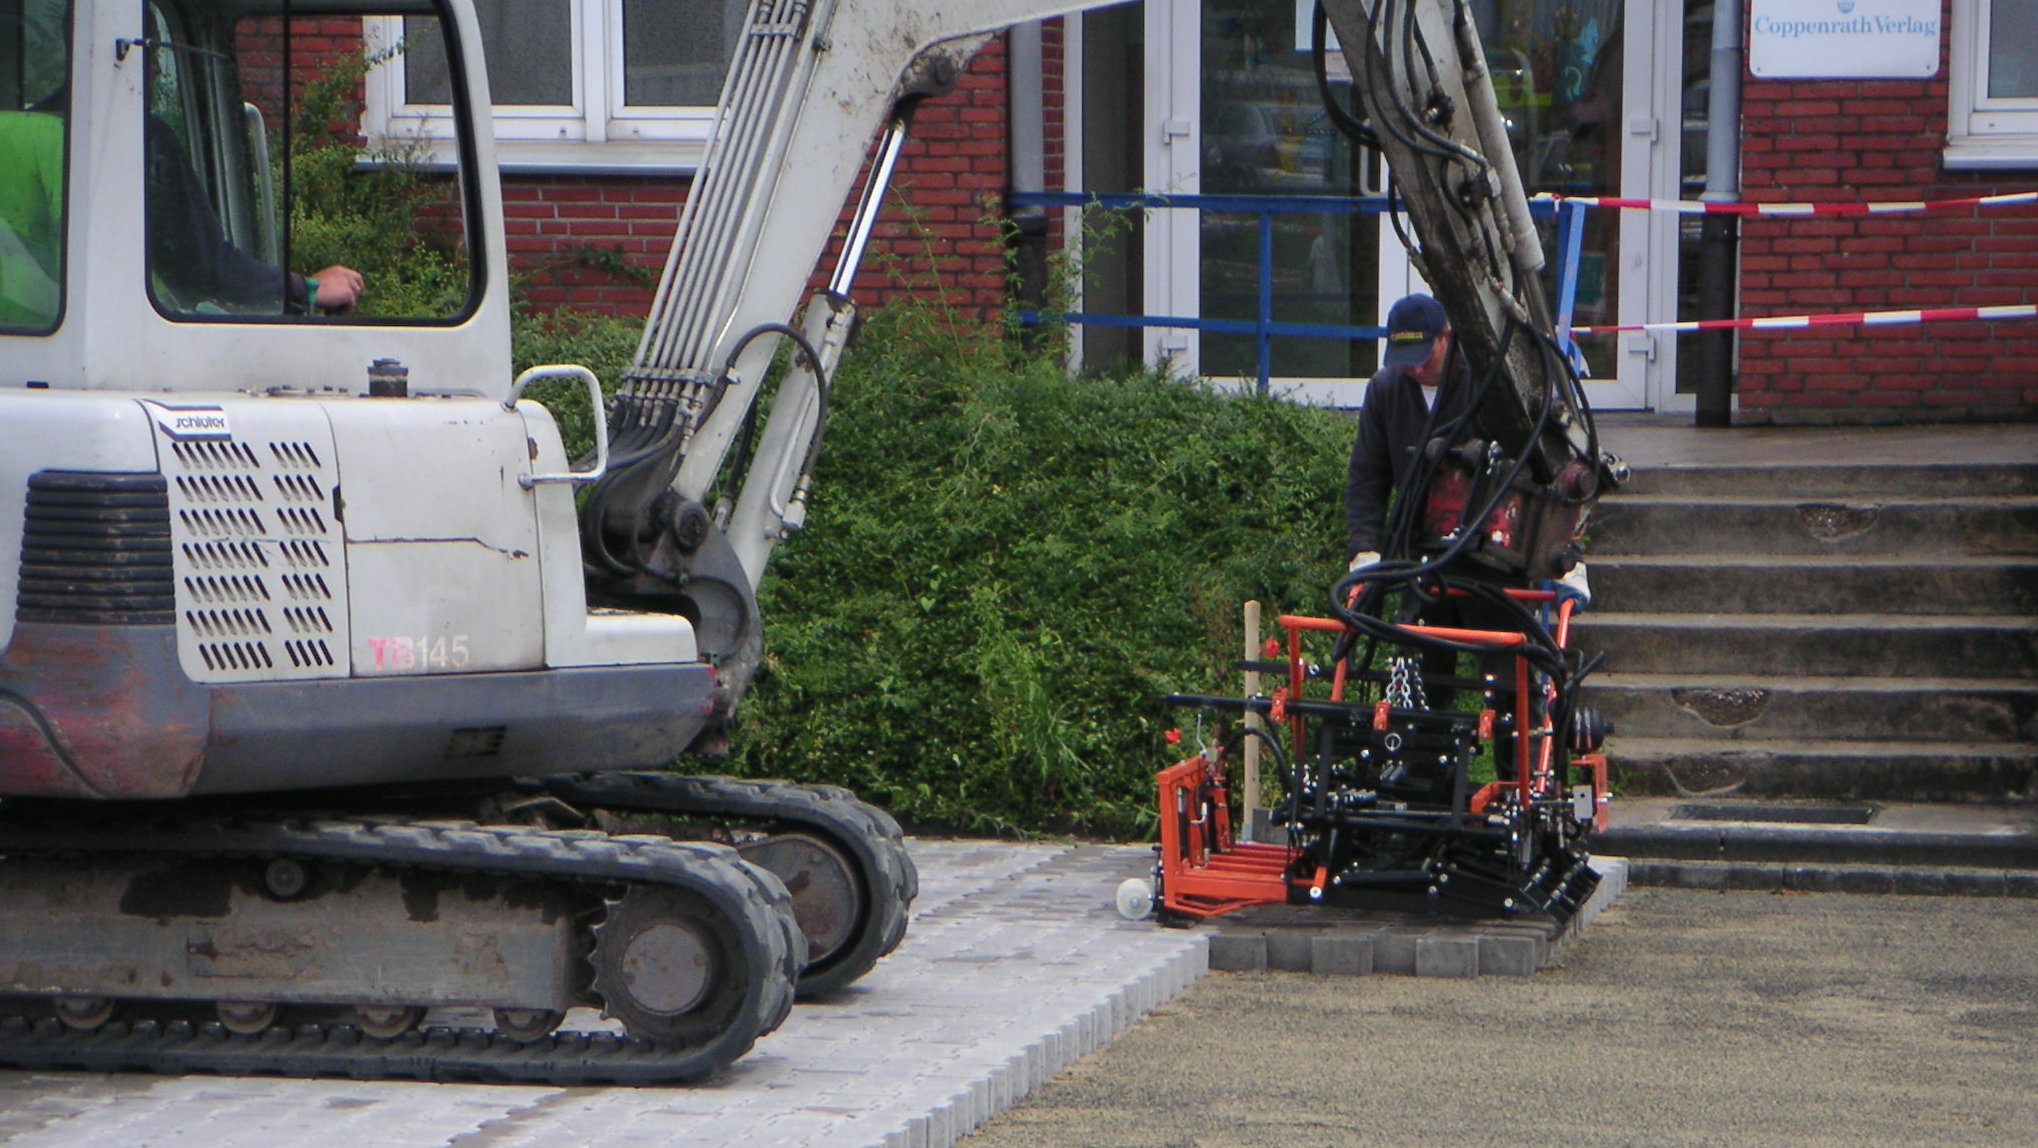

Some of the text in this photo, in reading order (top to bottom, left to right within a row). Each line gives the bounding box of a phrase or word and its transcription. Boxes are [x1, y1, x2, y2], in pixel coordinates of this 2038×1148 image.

[1754, 16, 1936, 37] Coppenrath Verlag
[367, 635, 470, 670] TB145
